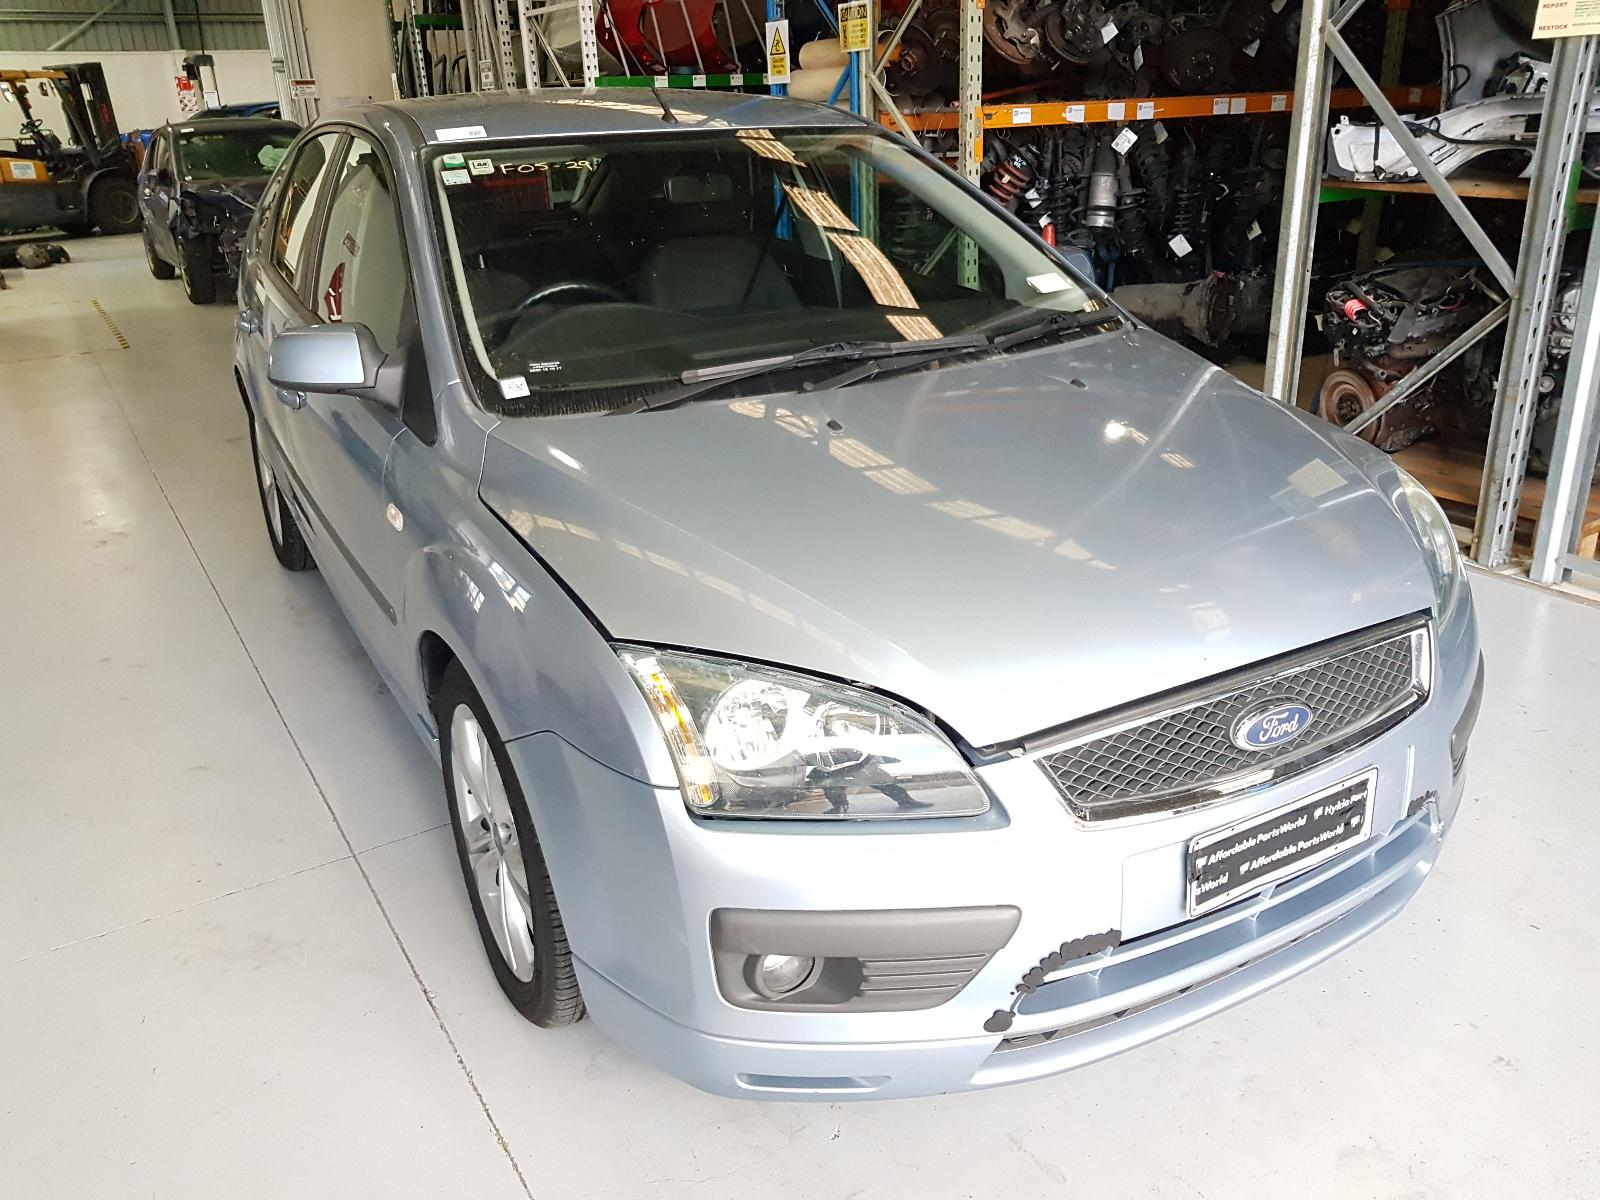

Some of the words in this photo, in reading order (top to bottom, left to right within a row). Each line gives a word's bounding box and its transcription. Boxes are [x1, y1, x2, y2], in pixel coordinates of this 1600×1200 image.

[840, 5, 868, 21] CAUTION
[1259, 712, 1299, 742] Ford
[1207, 837, 1256, 866] Affordable
[1250, 843, 1296, 871] Affordable
